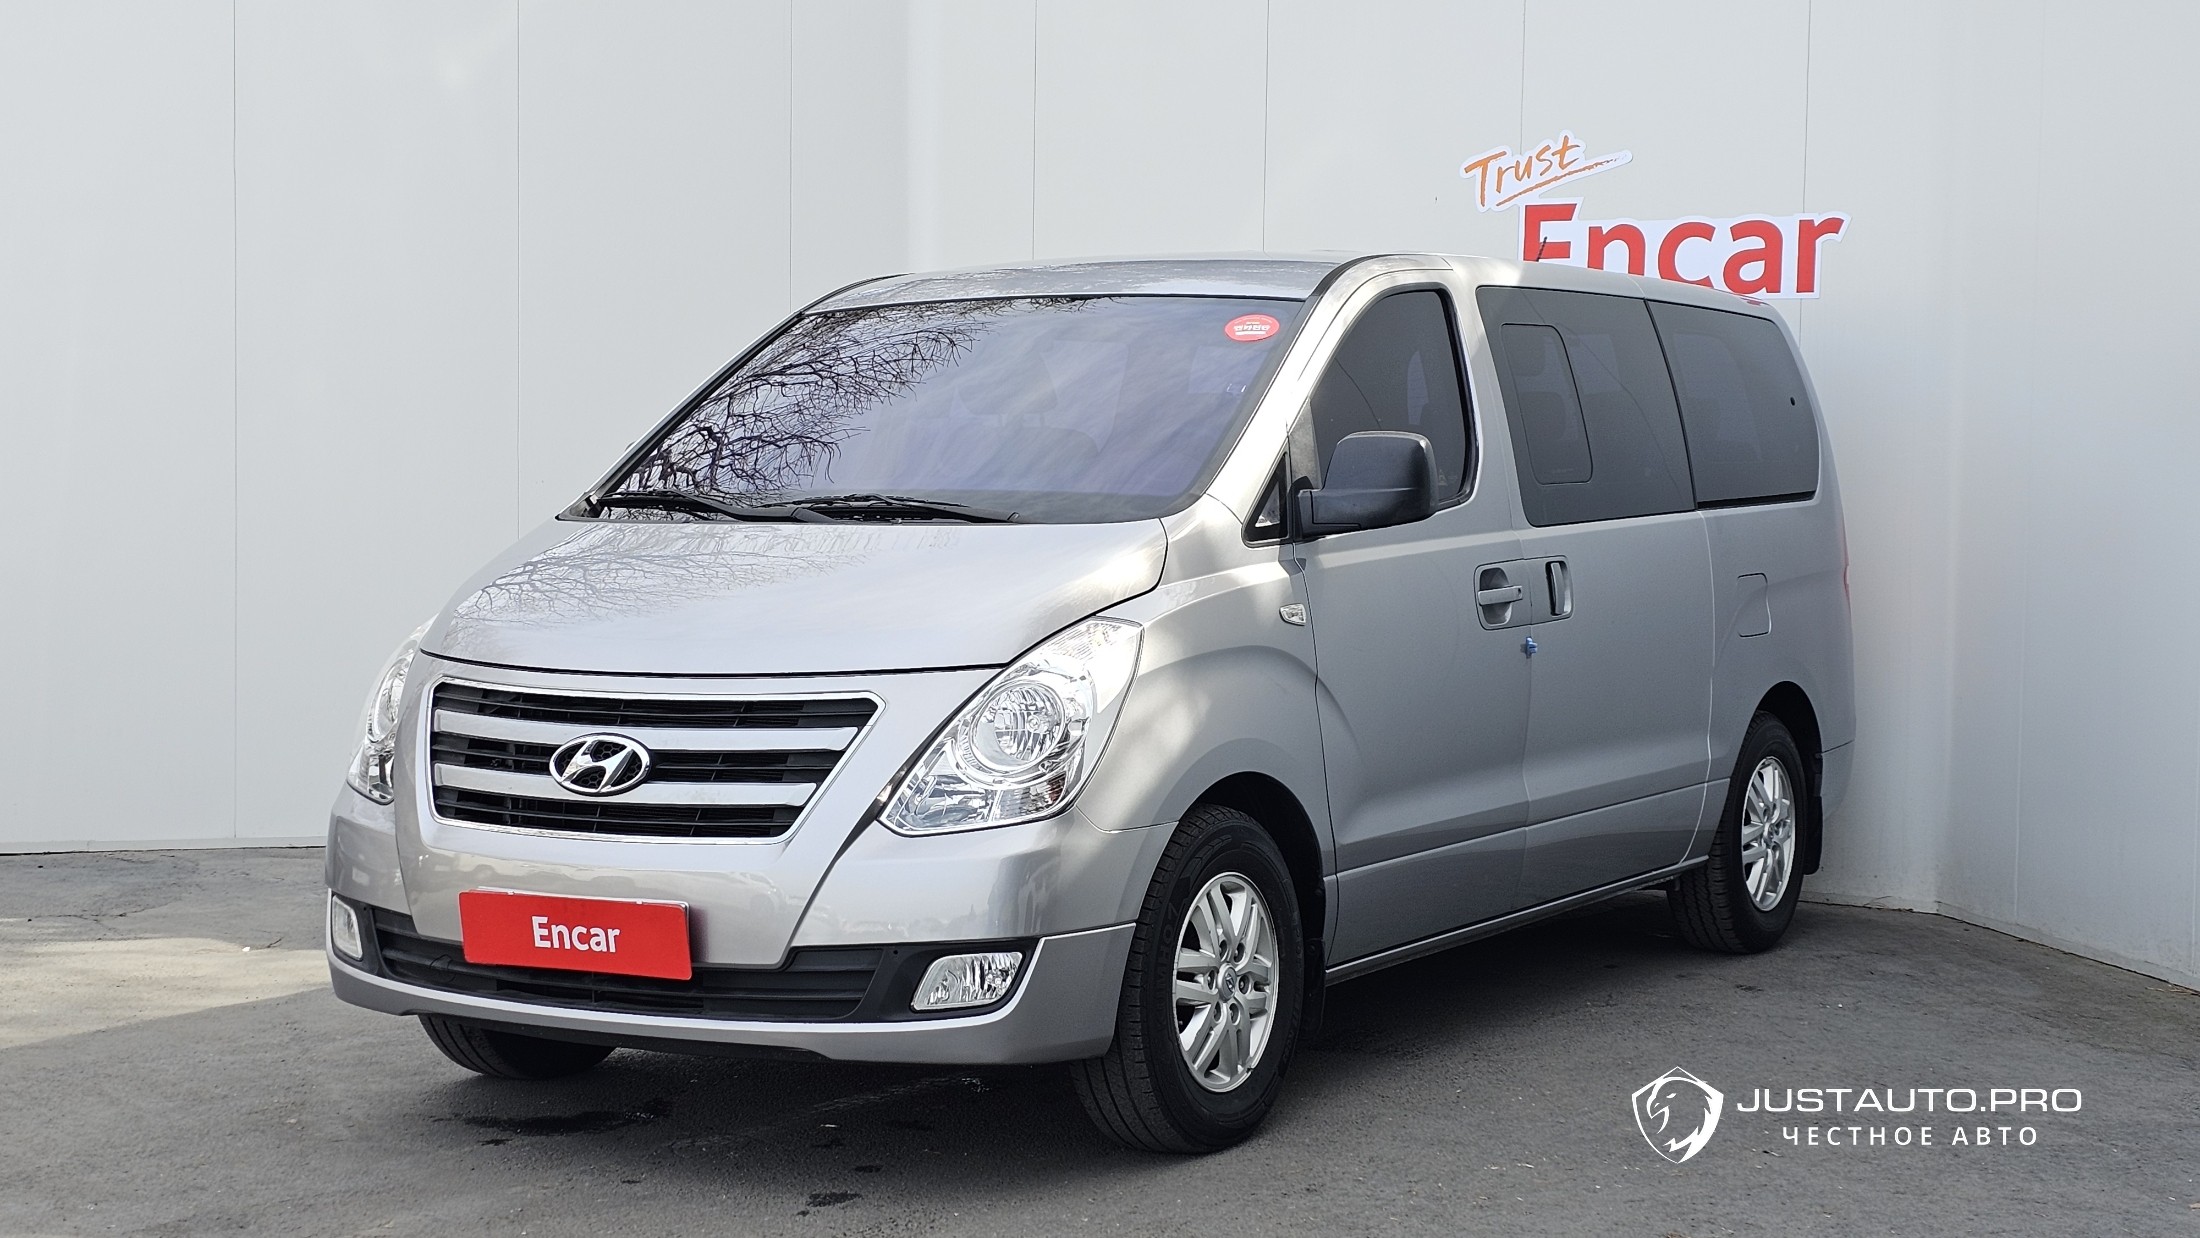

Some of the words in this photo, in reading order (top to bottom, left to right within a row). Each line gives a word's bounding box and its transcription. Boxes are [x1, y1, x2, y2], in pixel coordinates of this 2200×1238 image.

[1464, 135, 1580, 207] Trust
[1523, 203, 1844, 293] Encar
[531, 916, 620, 952] Encar
